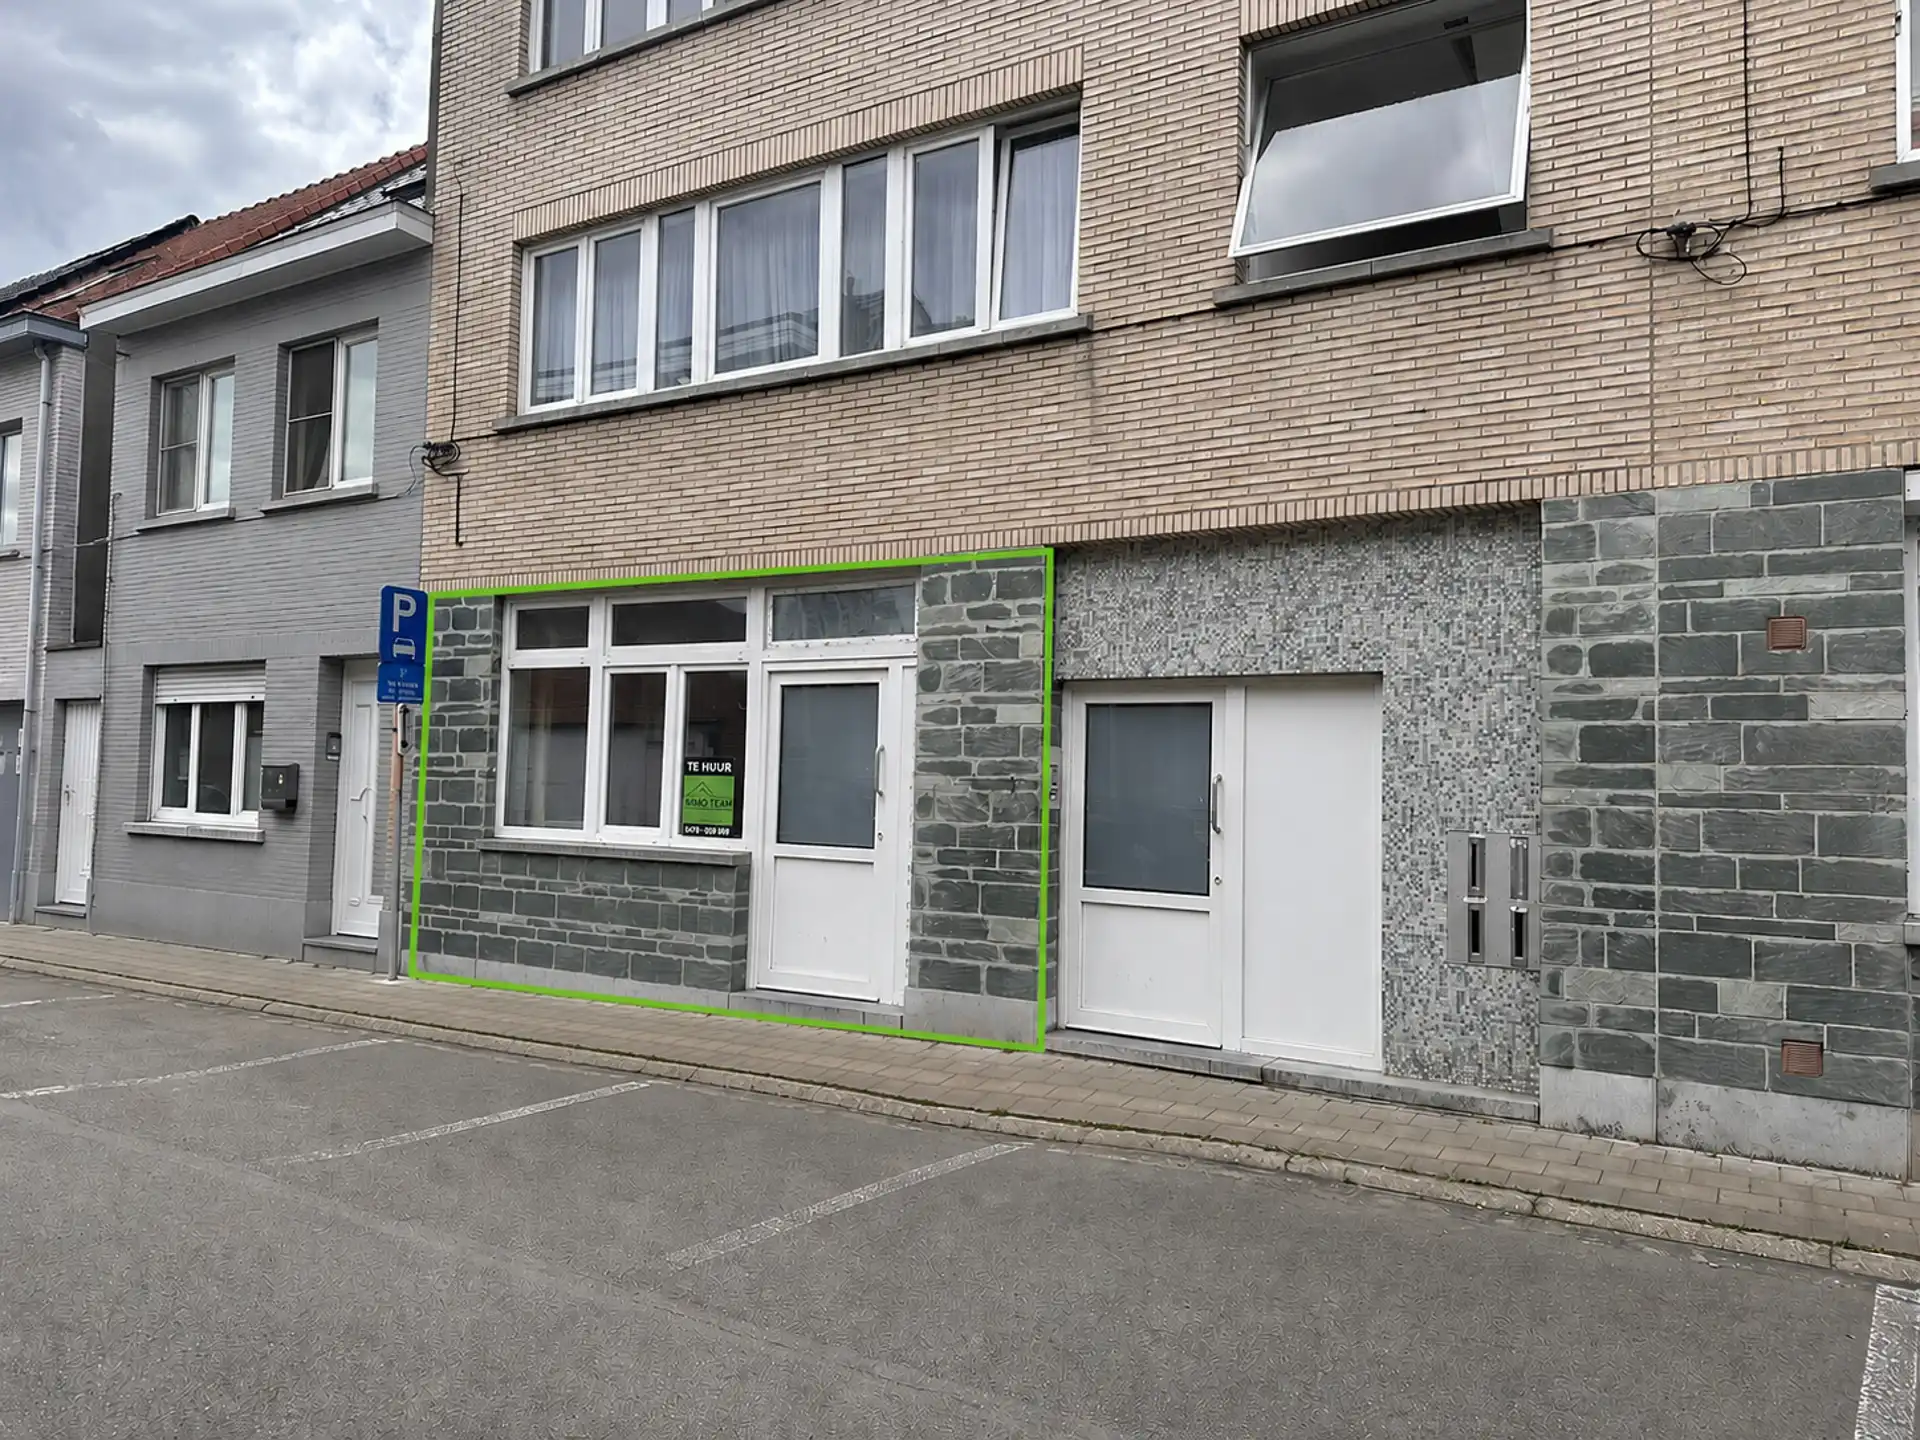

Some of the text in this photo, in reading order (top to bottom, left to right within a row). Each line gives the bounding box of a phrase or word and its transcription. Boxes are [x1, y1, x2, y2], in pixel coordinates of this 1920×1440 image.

[392, 592, 417, 632] P
[687, 761, 732, 773] TE HUUR
